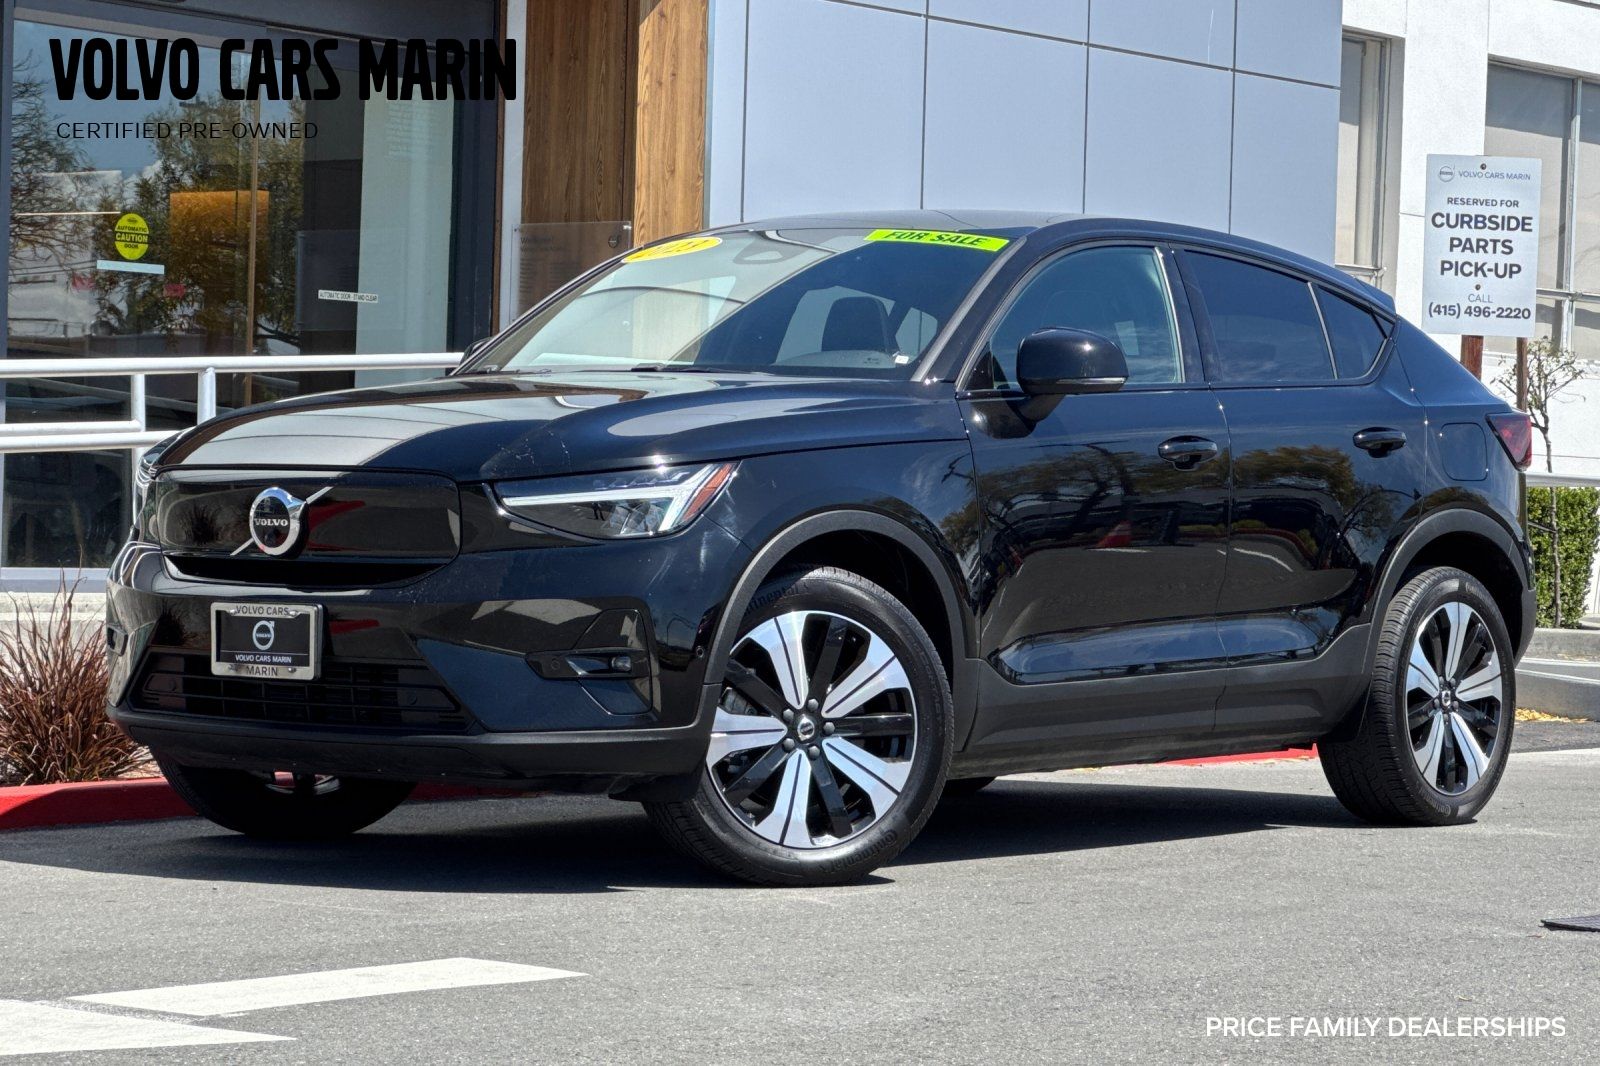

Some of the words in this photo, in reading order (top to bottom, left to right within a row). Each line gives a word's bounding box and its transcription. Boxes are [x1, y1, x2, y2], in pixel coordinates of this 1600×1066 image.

[1458, 170, 1484, 179] VOLVO
[1484, 171, 1505, 180] CARS
[1506, 173, 1531, 181] MARIN
[1447, 197, 1498, 207] RESERVED
[1499, 199, 1520, 208] FOR
[1431, 212, 1533, 232] CURBSIDE
[117, 225, 148, 233] AUTOMATIC
[115, 232, 149, 243] CAUTION
[882, 231, 927, 241] FOR
[929, 233, 988, 246] SALE
[1449, 237, 1514, 255] PARTS
[1440, 259, 1522, 279] PICK-UP
[1468, 293, 1494, 303] CALL
[1428, 302, 1461, 319] (415)
[1464, 305, 1532, 319] 496-2220
[253, 518, 289, 527] VOLVO
[236, 605, 265, 615] VOLVO
[266, 606, 290, 616] CARS
[235, 654, 255, 662] VOLVO
[255, 655, 271, 663] CARS
[272, 655, 292, 664] MARIN
[245, 666, 278, 676] MARIN
